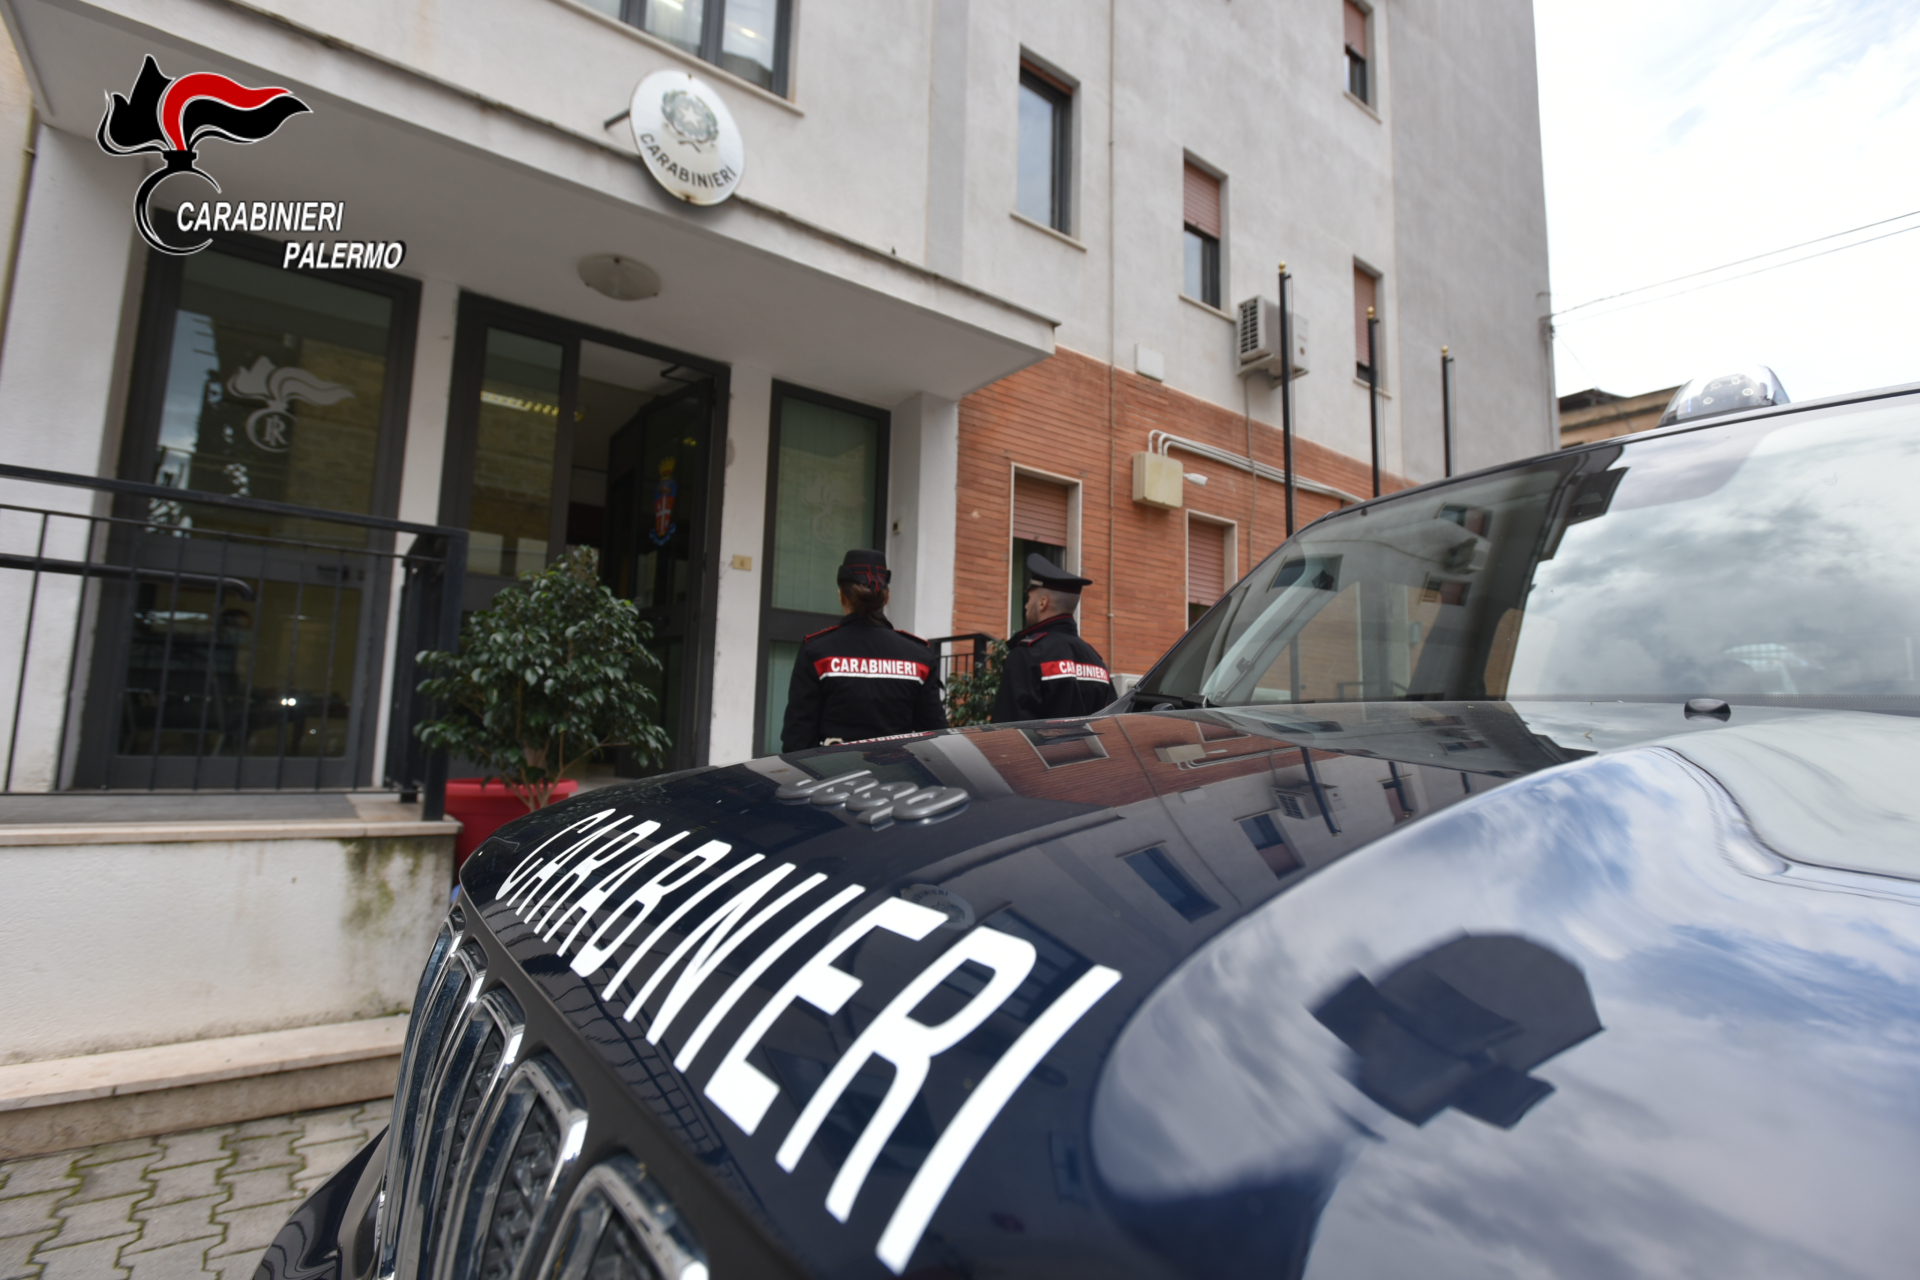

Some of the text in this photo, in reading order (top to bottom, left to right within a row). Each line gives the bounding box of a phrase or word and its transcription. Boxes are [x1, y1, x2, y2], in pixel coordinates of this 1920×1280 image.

[640, 132, 737, 188] CARABINIERI
[830, 658, 917, 676] CARABINIERI
[1058, 661, 1108, 680] CABINIERI
[775, 769, 969, 825] Jeep
[495, 808, 1122, 1275] CARABINIERI
